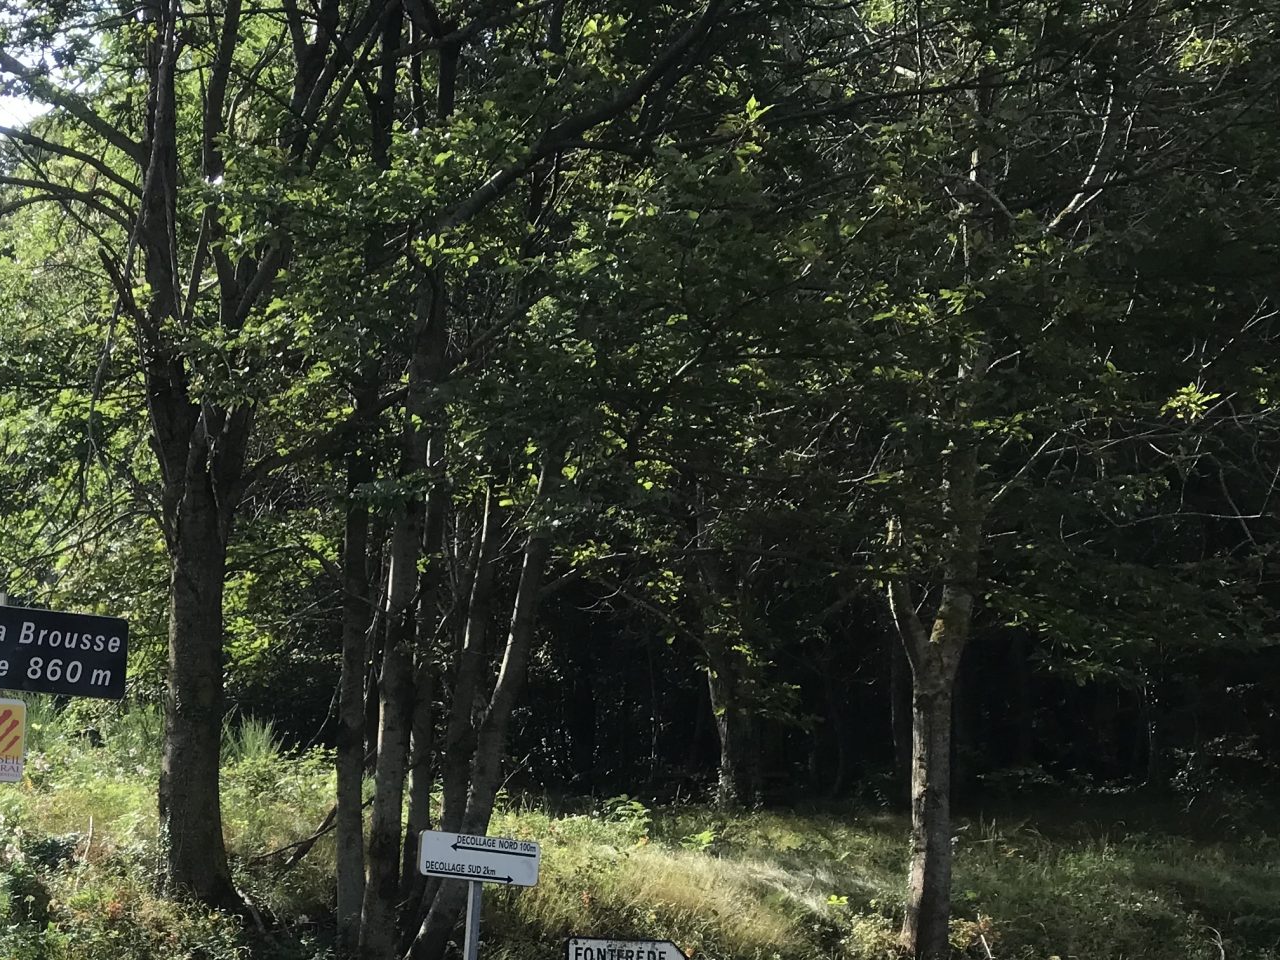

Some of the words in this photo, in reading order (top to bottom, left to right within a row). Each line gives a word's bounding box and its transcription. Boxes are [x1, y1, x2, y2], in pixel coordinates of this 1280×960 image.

[18, 621, 121, 653] Brousse
[26, 656, 83, 683] 860
[90, 667, 112, 686] m
[457, 835, 496, 848] DECOLLAGE
[498, 840, 518, 851] NORD
[425, 860, 465, 873] DECOLLAGE
[467, 864, 482, 874] SUD
[482, 866, 496, 876] 2km
